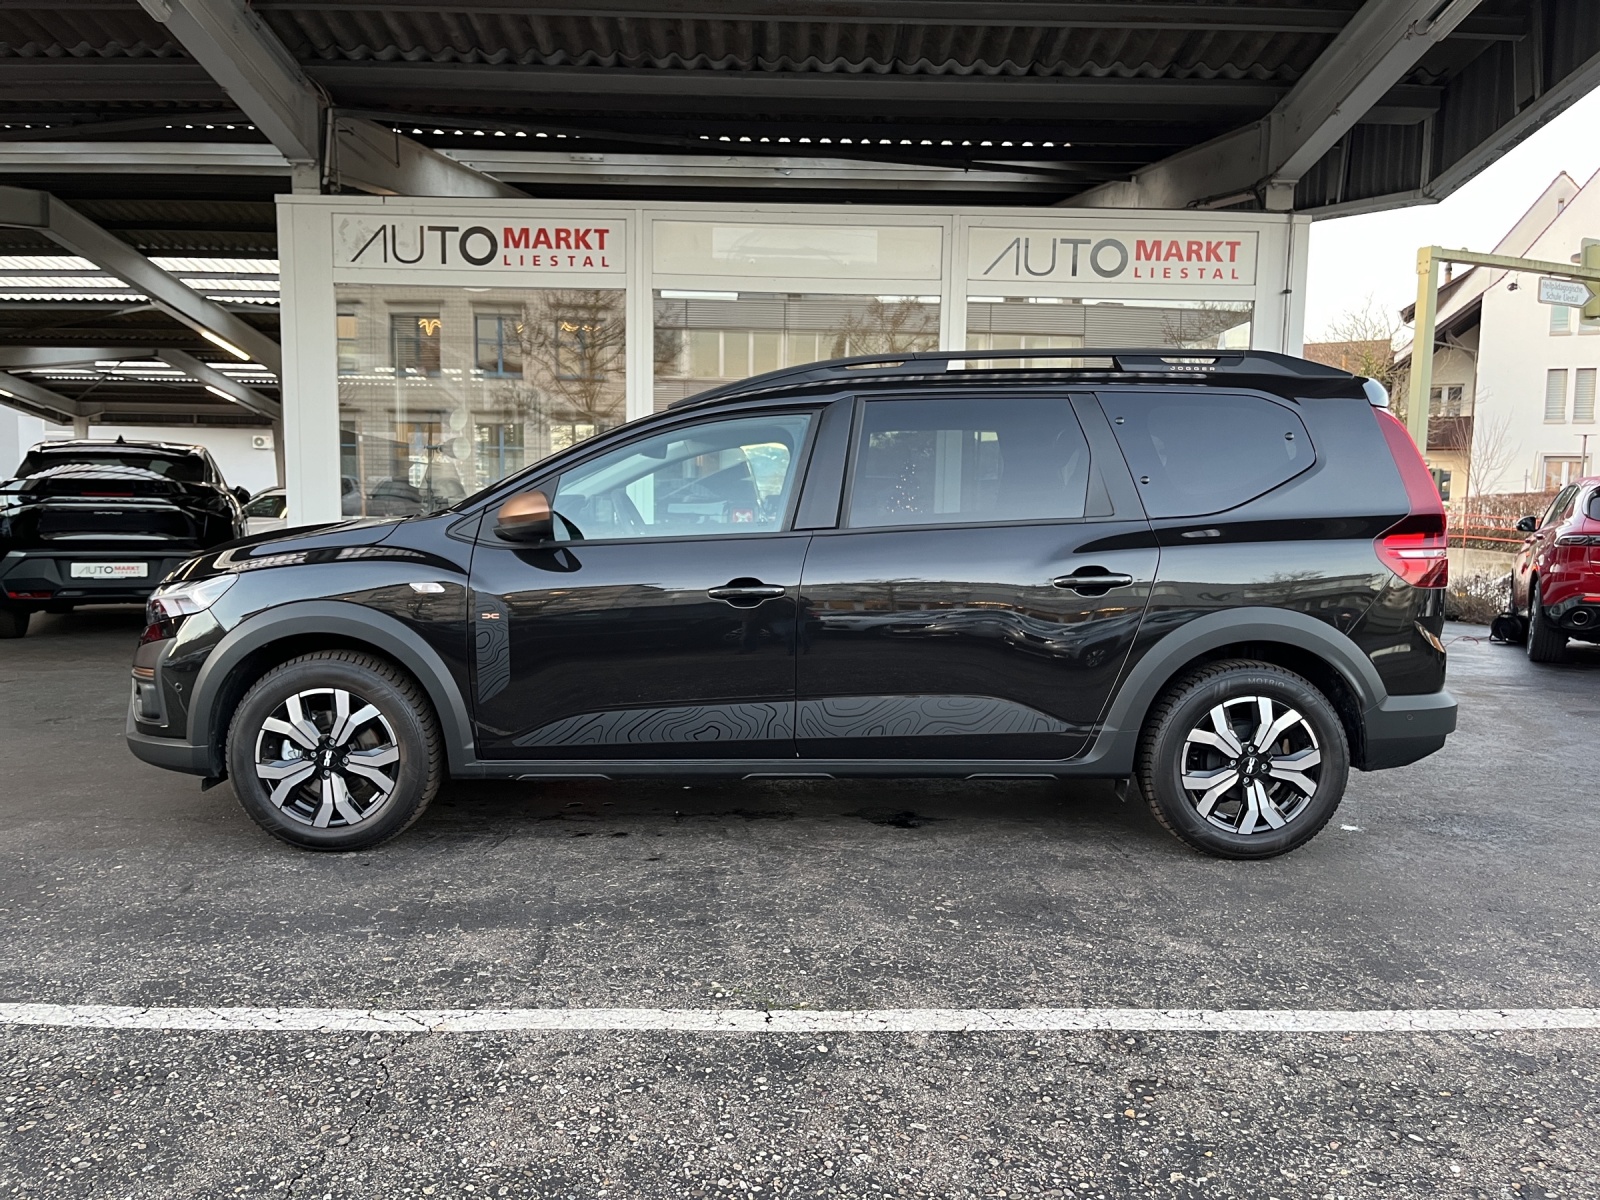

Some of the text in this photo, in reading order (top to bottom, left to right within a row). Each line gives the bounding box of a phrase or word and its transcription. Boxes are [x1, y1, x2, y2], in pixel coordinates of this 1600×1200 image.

[350, 224, 610, 266] AUTO MARKT
[503, 254, 610, 268] LIESTAL
[982, 237, 1241, 278] AUTO MARKT
[1134, 266, 1239, 280] LIESTAL
[79, 566, 114, 574] AUTO
[1248, 677, 1285, 688] MOTRIO
